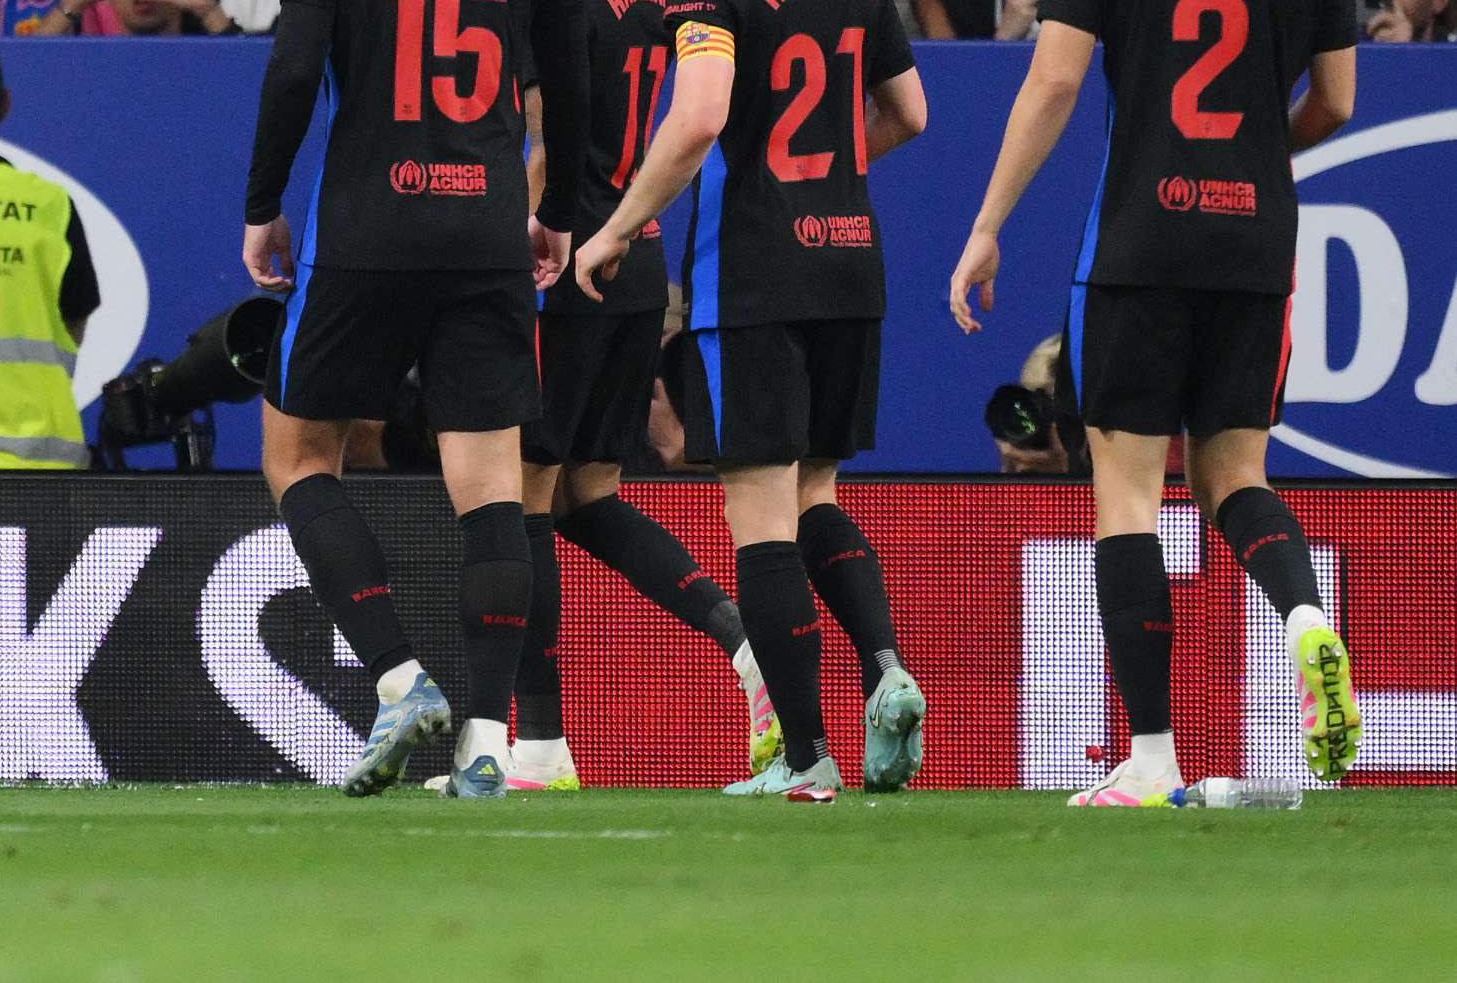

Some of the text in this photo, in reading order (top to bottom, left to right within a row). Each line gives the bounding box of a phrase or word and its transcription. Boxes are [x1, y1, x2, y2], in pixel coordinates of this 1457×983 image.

[767, 27, 867, 182] 21
[610, 45, 669, 190] 11
[429, 164, 486, 177] UNHCR
[429, 177, 487, 190] ACNUR
[1199, 179, 1255, 197] UNHCR
[1199, 195, 1256, 211] ACNUR
[828, 216, 870, 229] UNHCR
[829, 229, 872, 241] ACNUR
